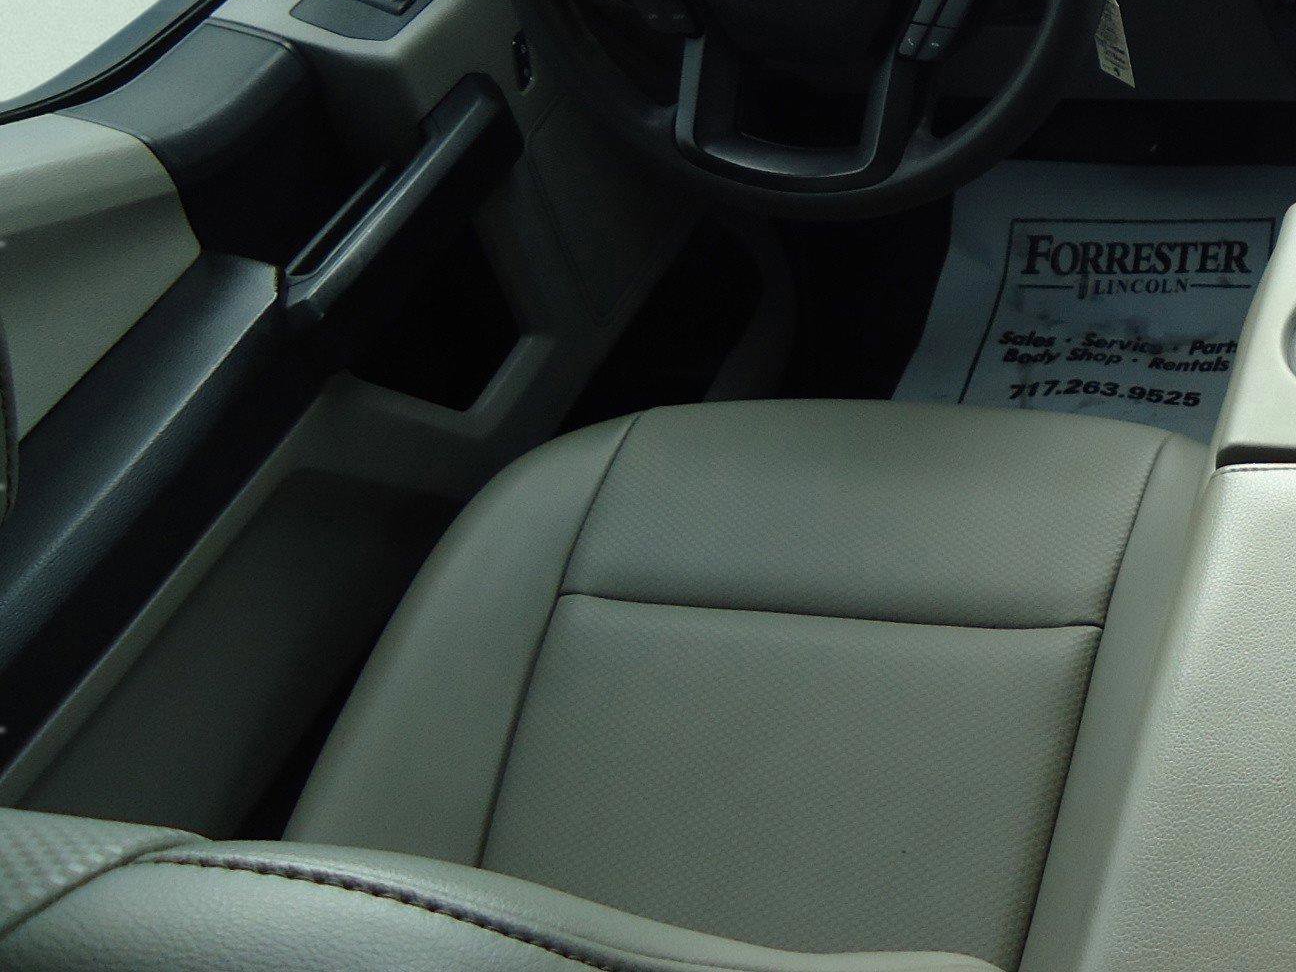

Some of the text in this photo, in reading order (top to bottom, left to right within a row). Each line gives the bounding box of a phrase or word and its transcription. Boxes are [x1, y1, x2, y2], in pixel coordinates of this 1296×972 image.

[1020, 234, 1252, 277] FORRESTER
[1092, 278, 1189, 296] LINCOLN
[998, 330, 1056, 348] Sales
[1002, 347, 1230, 373] Body Shop Rentals
[1009, 378, 1201, 407] 717.263.9525
